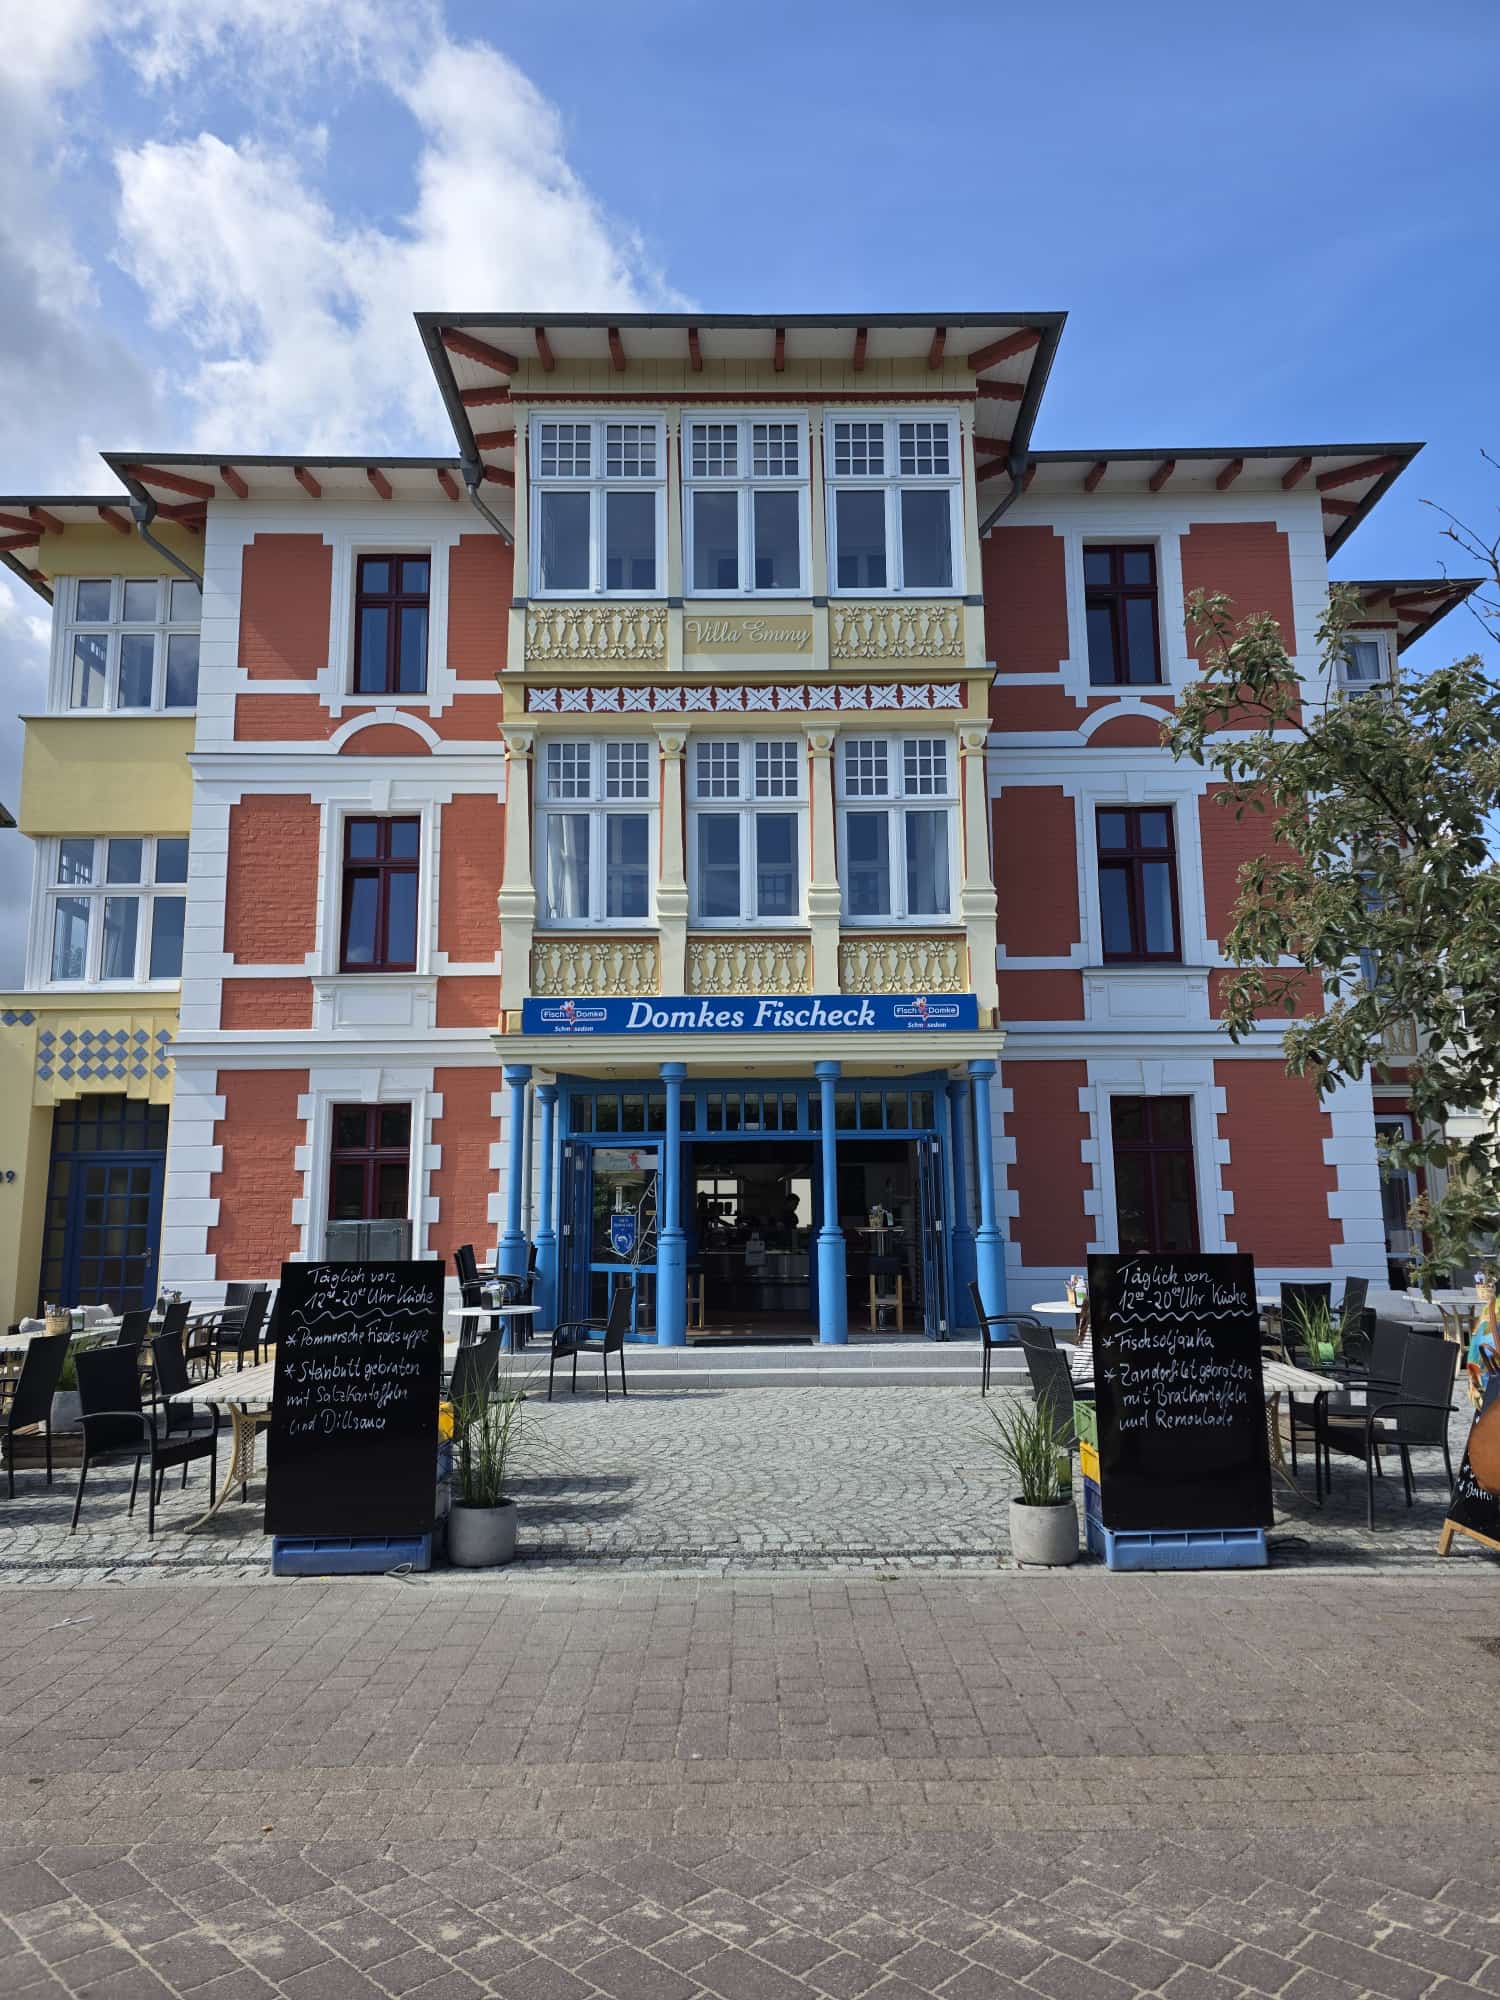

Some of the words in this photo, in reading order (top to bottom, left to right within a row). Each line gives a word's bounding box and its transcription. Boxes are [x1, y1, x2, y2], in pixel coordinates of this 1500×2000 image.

[686, 620, 742, 643] Villa
[743, 619, 811, 650] Emmy
[543, 1010, 565, 1018] Fisch
[575, 1010, 604, 1018] Domke
[626, 1001, 745, 1029] Domkes
[753, 999, 876, 1027] Fischeck
[896, 1006, 917, 1014] Fisch
[928, 1006, 956, 1014] Domke
[307, 1265, 365, 1289] Täglich
[371, 1271, 397, 1283] von
[1116, 1259, 1179, 1291] Täglich
[1183, 1271, 1213, 1283] von
[367, 1287, 395, 1305] Uhr
[1178, 1285, 1206, 1309] Uhr
[297, 1355, 361, 1382] Steinbutt
[364, 1354, 420, 1381] gebraten
[286, 1387, 311, 1408] mit
[1122, 1386, 1150, 1407] mit
[1119, 1409, 1149, 1431] und
[1155, 1407, 1233, 1429] Remoulade
